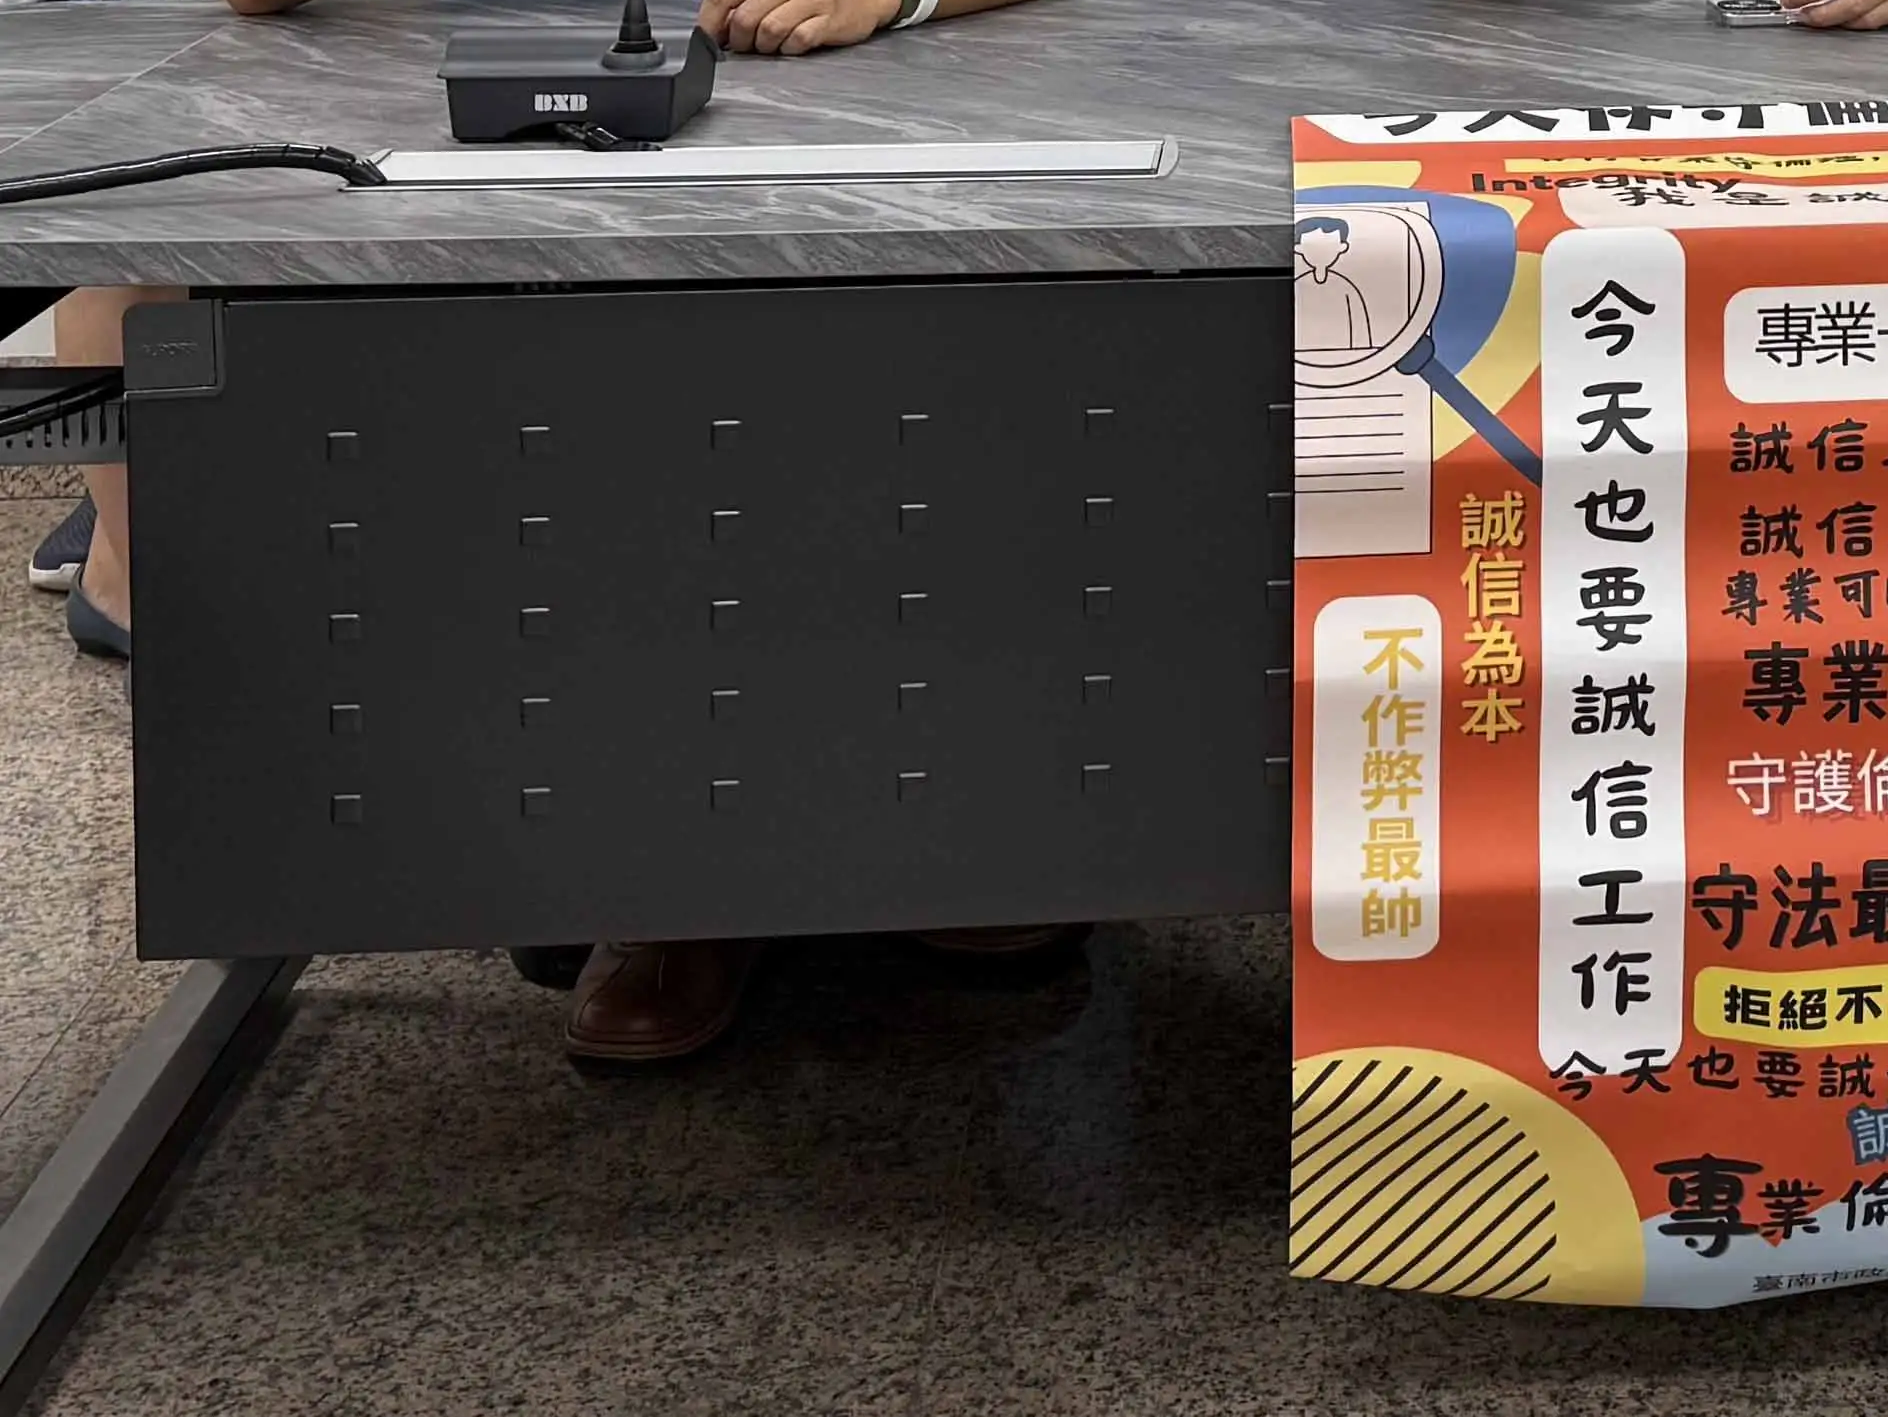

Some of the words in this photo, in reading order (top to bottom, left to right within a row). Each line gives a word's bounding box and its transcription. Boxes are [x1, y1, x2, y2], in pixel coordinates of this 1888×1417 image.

[534, 94, 588, 112] BXB
[1471, 170, 1741, 195] Integrity
[1458, 492, 1526, 744] 誠信為本
[1571, 279, 1655, 1016] 今天也要誠信工作
[1360, 627, 1425, 940] 不作弊最帥
